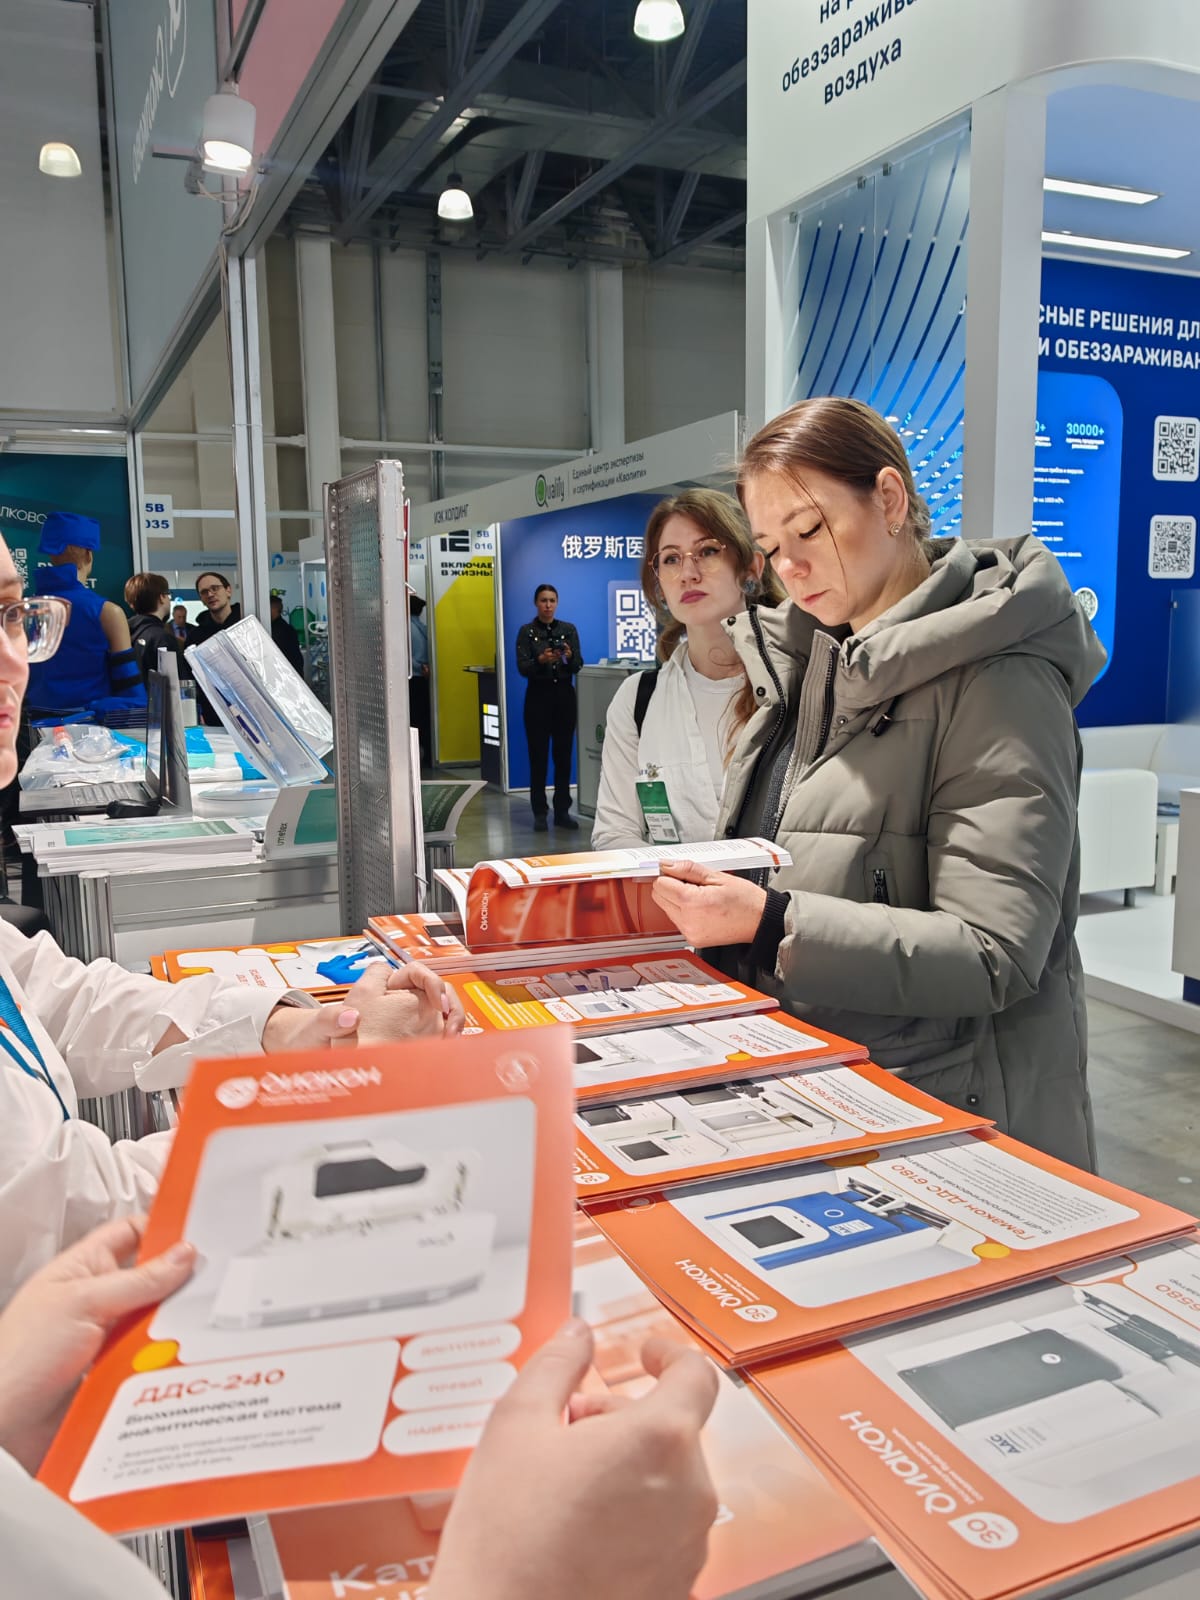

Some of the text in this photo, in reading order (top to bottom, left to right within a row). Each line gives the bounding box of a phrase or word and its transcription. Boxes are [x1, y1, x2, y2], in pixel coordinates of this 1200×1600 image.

[824, 38, 902, 105] воздуха
[1090, 309, 1174, 336] РЕШЕНИЯ
[1066, 422, 1104, 436] 30000+
[572, 452, 645, 480] Единый центр экспертизы
[145, 503, 165, 512] 5B
[561, 534, 645, 560] 俄罗斯医
[891, 1164, 1036, 1241] Гемакон ДДС 6180
[133, 1368, 286, 1407] ДДС-240
[117, 1400, 342, 1441] аналитическая система
[125, 1396, 270, 1426] Биохимическая
[966, 1518, 1002, 1544] 30
